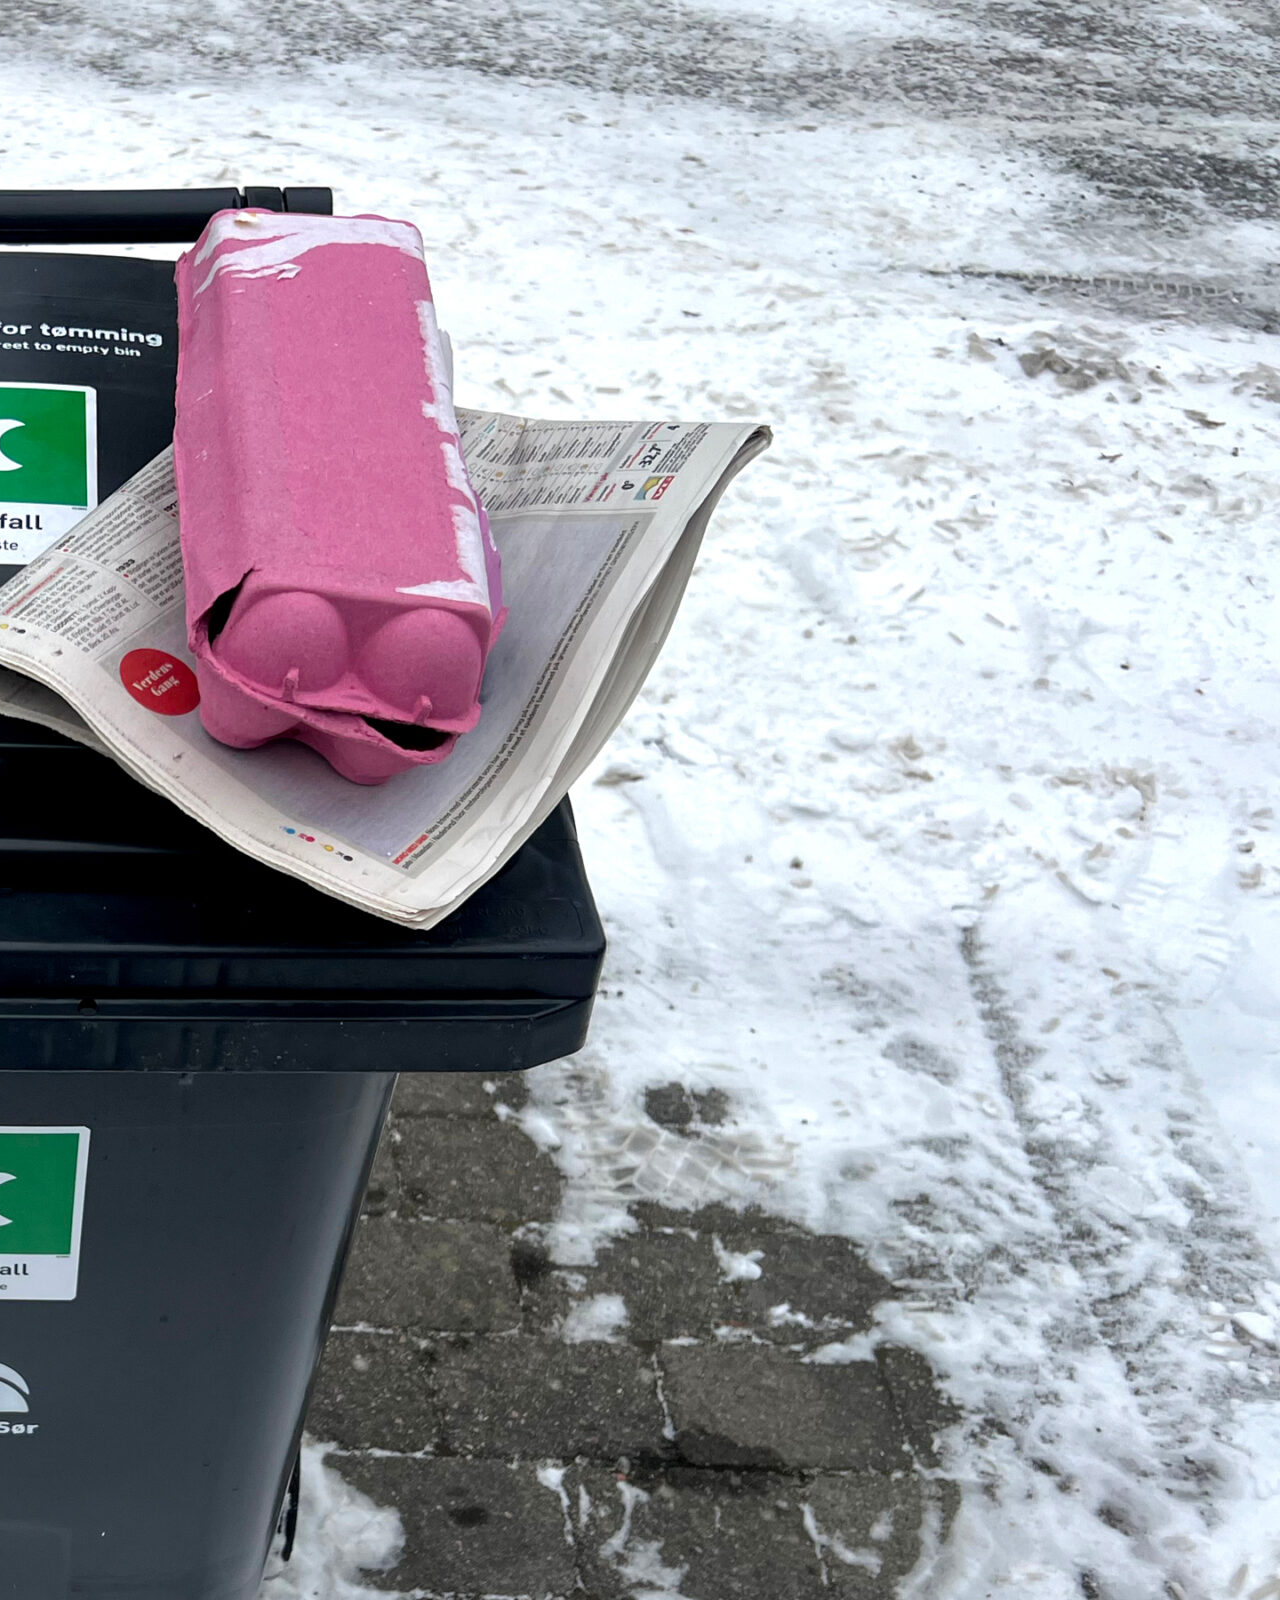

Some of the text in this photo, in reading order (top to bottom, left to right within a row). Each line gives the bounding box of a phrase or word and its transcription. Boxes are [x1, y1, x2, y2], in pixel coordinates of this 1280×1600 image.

[39, 323, 163, 347] tømming
[33, 342, 52, 352] to
[55, 343, 110, 356] empty
[114, 345, 141, 357] bin
[132, 662, 173, 691] Verdens
[150, 675, 180, 697] Gang
